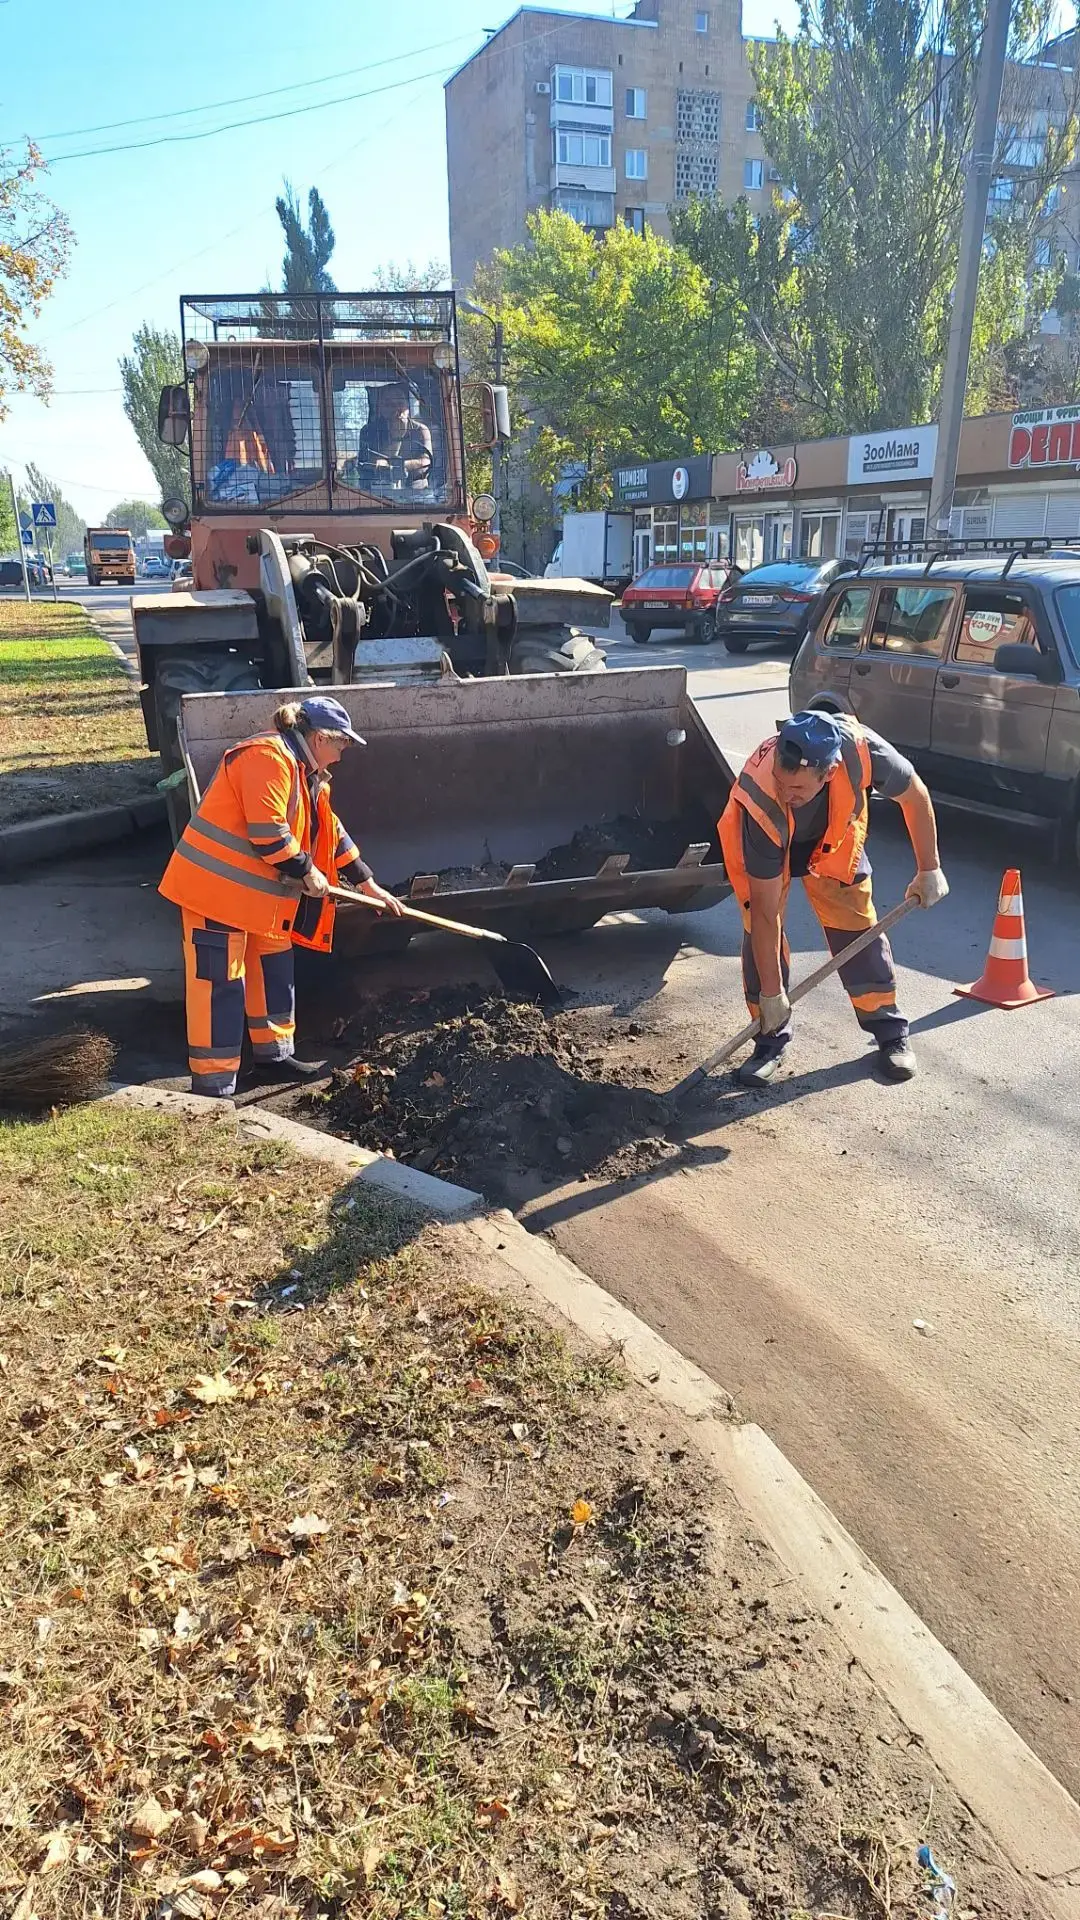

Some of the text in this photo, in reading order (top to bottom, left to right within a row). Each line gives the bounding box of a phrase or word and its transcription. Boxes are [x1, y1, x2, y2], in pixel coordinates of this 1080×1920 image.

[1014, 411, 1043, 425] ОВОЩИ
[1047, 409, 1053, 421] И
[863, 440, 920, 461] ЗооМама
